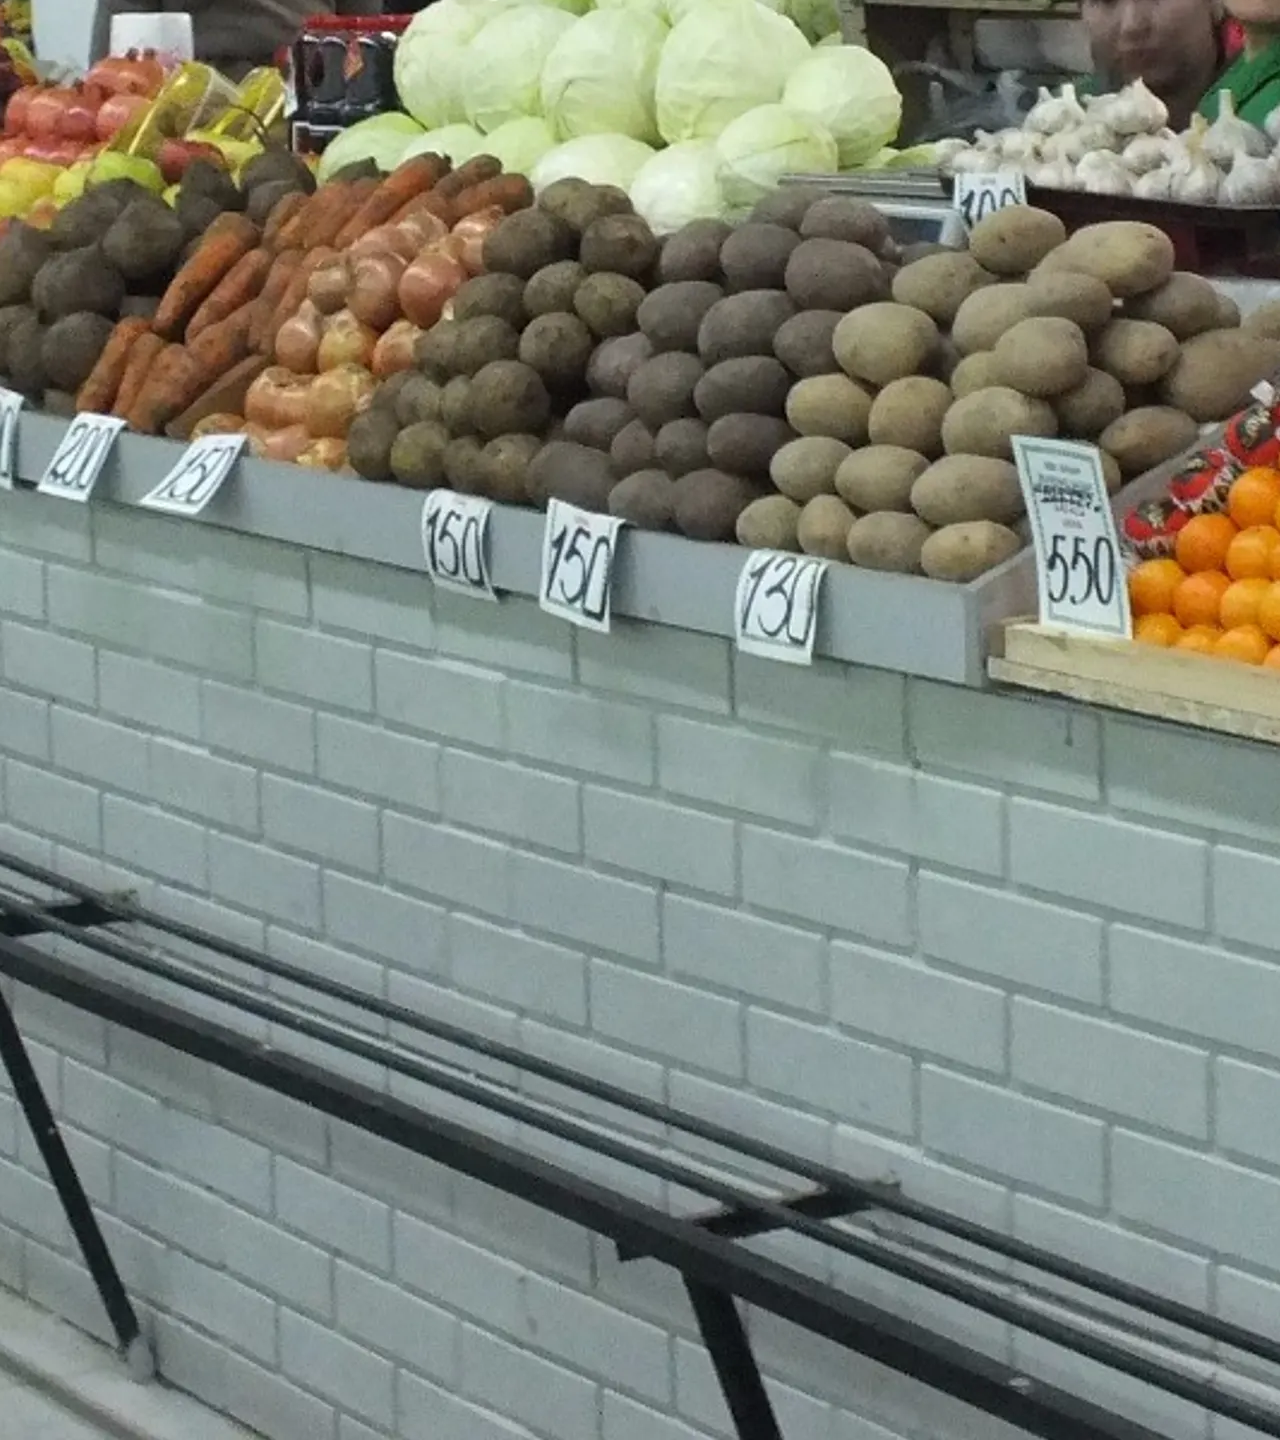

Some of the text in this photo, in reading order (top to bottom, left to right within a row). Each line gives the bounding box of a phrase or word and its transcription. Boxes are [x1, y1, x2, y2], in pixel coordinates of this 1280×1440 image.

[49, 422, 115, 489] 200
[156, 446, 236, 504] 150
[427, 508, 487, 587] 150
[545, 525, 612, 621] 150
[1048, 535, 1115, 605] 550
[740, 558, 819, 644] 130
